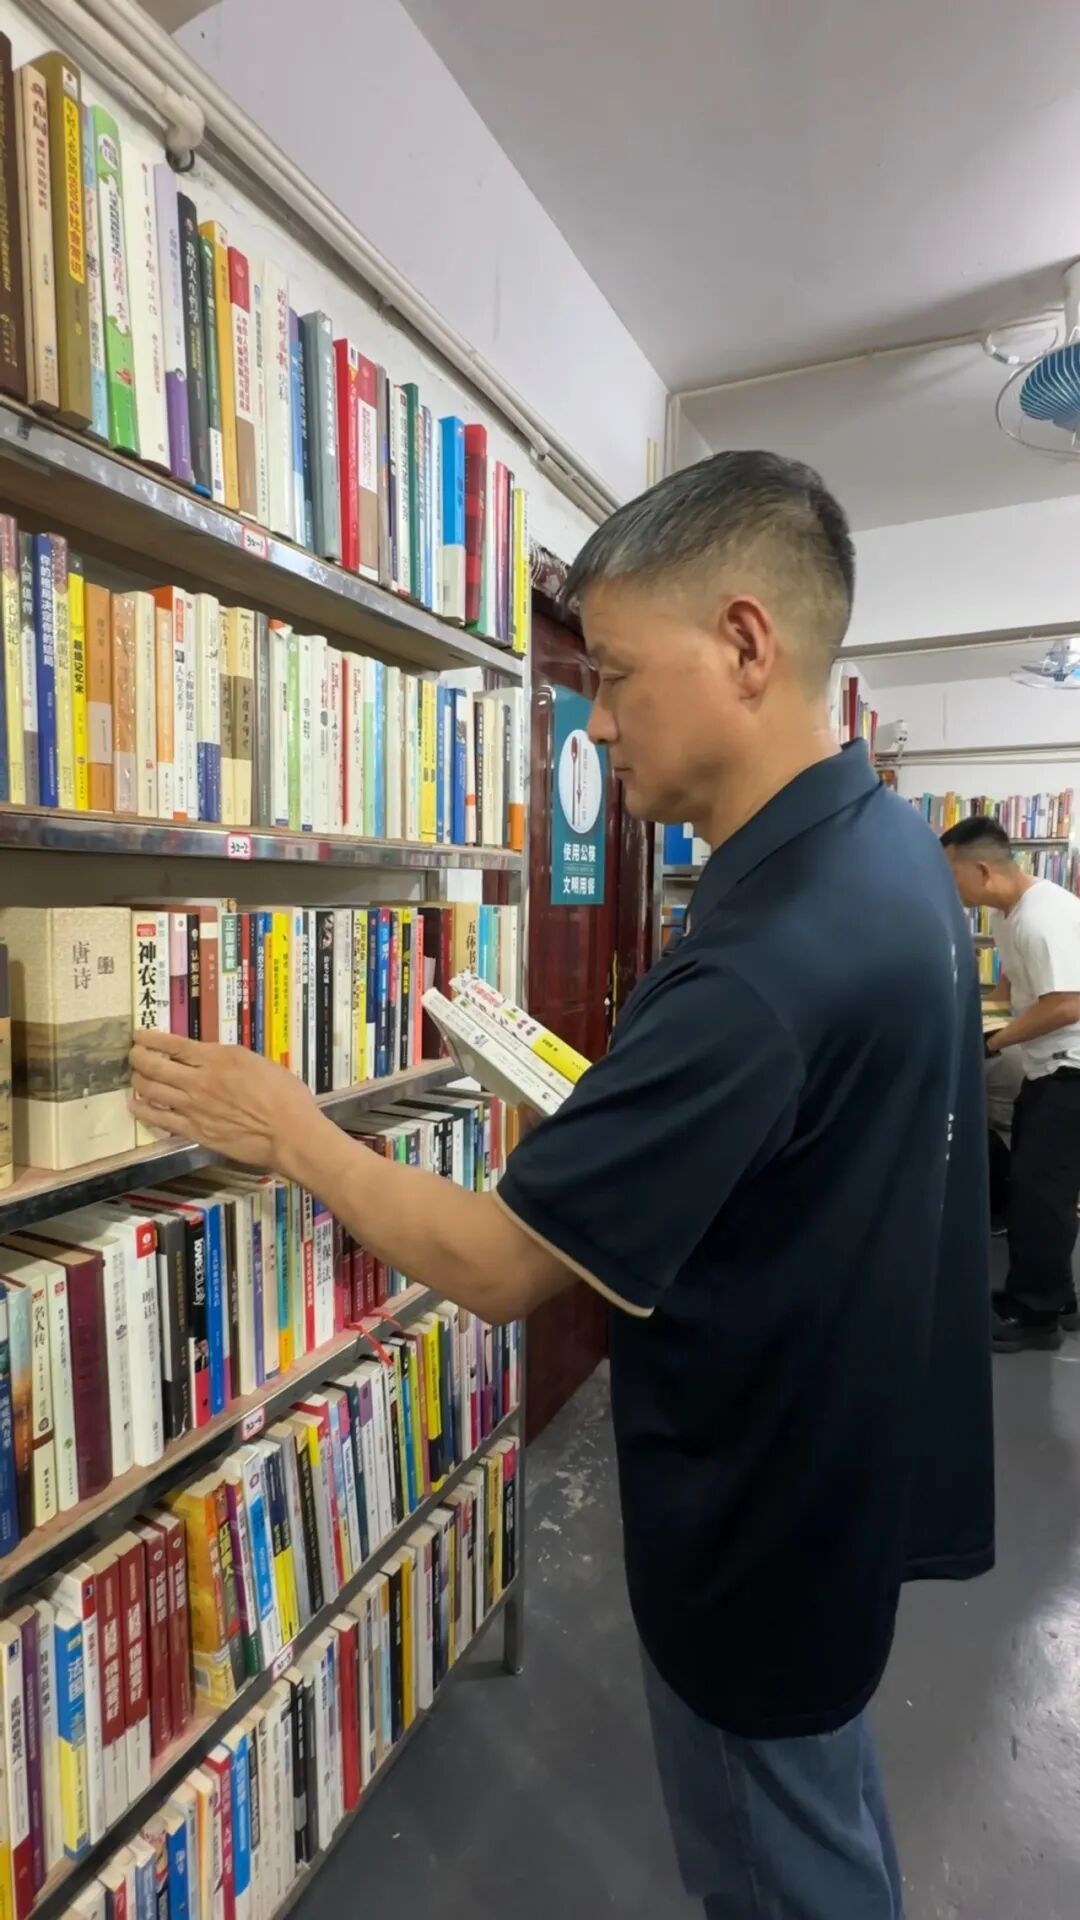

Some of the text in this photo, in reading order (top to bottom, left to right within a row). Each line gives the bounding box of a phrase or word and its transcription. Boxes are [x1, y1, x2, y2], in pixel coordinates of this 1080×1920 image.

[563, 876, 596, 895] 文明用餐
[72, 941, 91, 990] 唐诗
